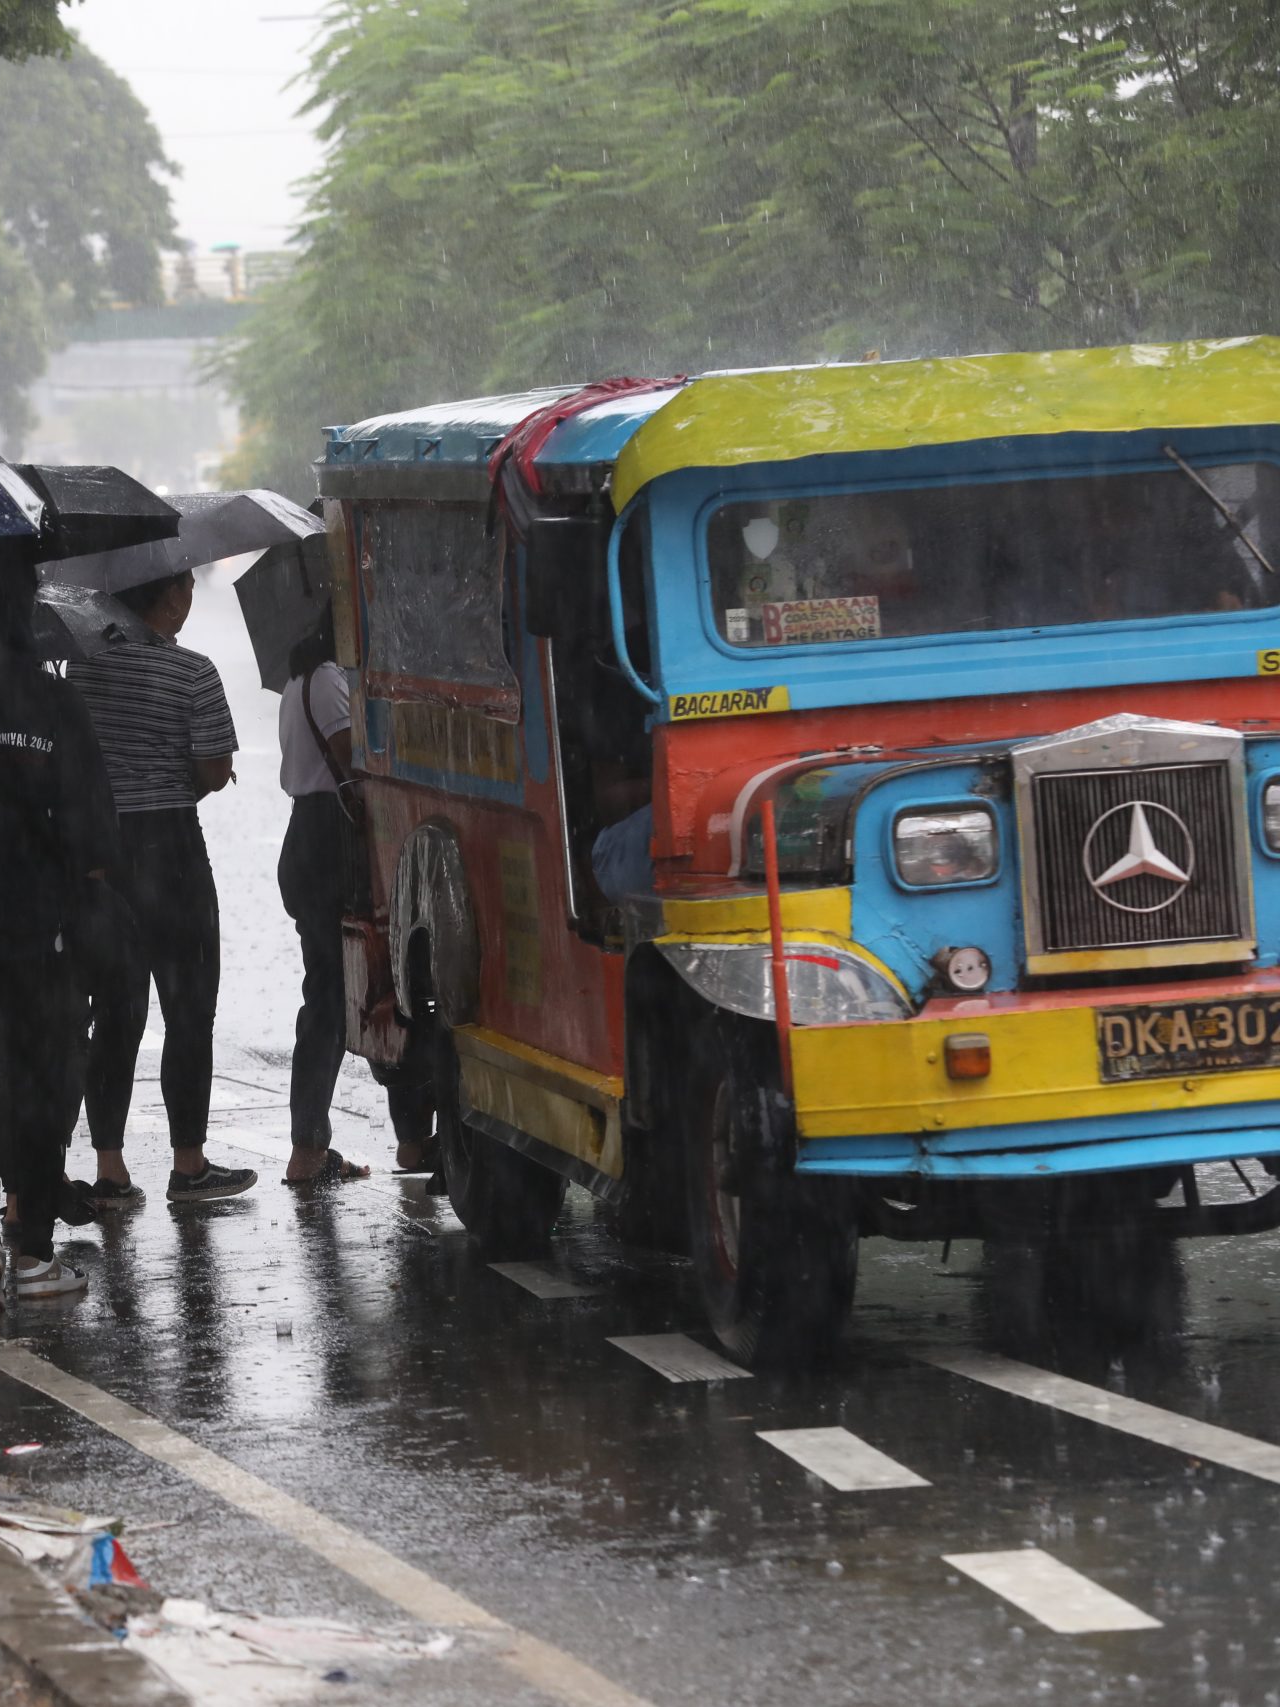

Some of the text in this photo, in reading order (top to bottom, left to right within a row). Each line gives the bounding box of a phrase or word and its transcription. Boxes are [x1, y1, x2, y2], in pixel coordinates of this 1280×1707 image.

[787, 625, 876, 641] HERITAGE
[673, 688, 769, 717] BACLARAN
[29, 736, 54, 753] 2018
